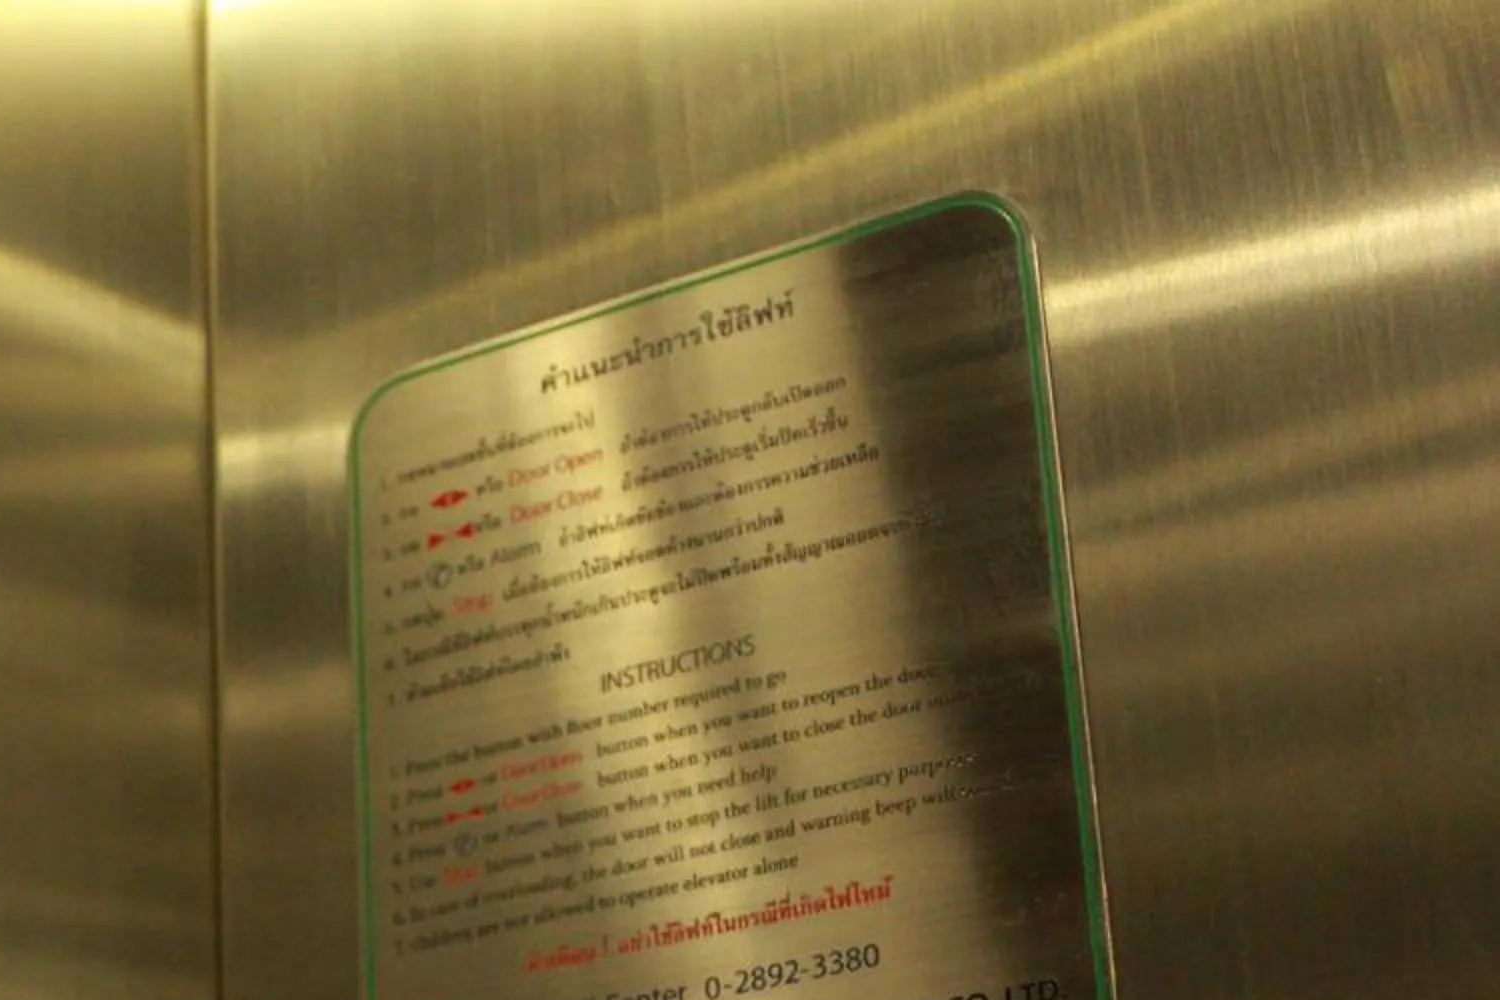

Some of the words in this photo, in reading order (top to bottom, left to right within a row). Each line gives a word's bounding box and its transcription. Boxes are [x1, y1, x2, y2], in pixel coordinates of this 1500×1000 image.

[600, 636, 757, 691] INSTRUCTIONS
[596, 735, 648, 757] button
[653, 723, 698, 742] when
[701, 715, 733, 732] you
[737, 702, 776, 720] want
[781, 698, 798, 711] to
[803, 683, 860, 706] reopen
[865, 673, 893, 691] the
[608, 700, 669, 724] number
[674, 678, 741, 707] required
[745, 676, 763, 690] to
[766, 671, 787, 689] go
[597, 765, 649, 787] button
[654, 753, 698, 772] when
[703, 744, 733, 764] you
[739, 733, 777, 752] want
[782, 729, 800, 743] to
[803, 718, 845, 737] close
[849, 708, 877, 726] the
[882, 699, 921, 718] door
[586, 834, 617, 853] you
[621, 823, 660, 841] want
[666, 818, 684, 832] to
[687, 810, 720, 827] stop
[724, 801, 751, 818] the
[755, 793, 780, 811] lift
[784, 787, 808, 805] for
[813, 771, 892, 798] necessary
[613, 793, 659, 813] when
[662, 785, 692, 805] you
[697, 770, 737, 794] need
[740, 764, 779, 784] help
[581, 866, 608, 882] the
[610, 857, 649, 875] door
[653, 845, 686, 865] will
[689, 842, 716, 858] not
[720, 832, 761, 851] close
[764, 819, 795, 841] and
[800, 808, 872, 831] warning
[874, 797, 916, 815] beep
[598, 896, 616, 909] to
[617, 882, 679, 908] operate
[682, 866, 749, 891] elevator
[753, 855, 799, 875] alone
[703, 944, 881, 999] 0-2892-3380
